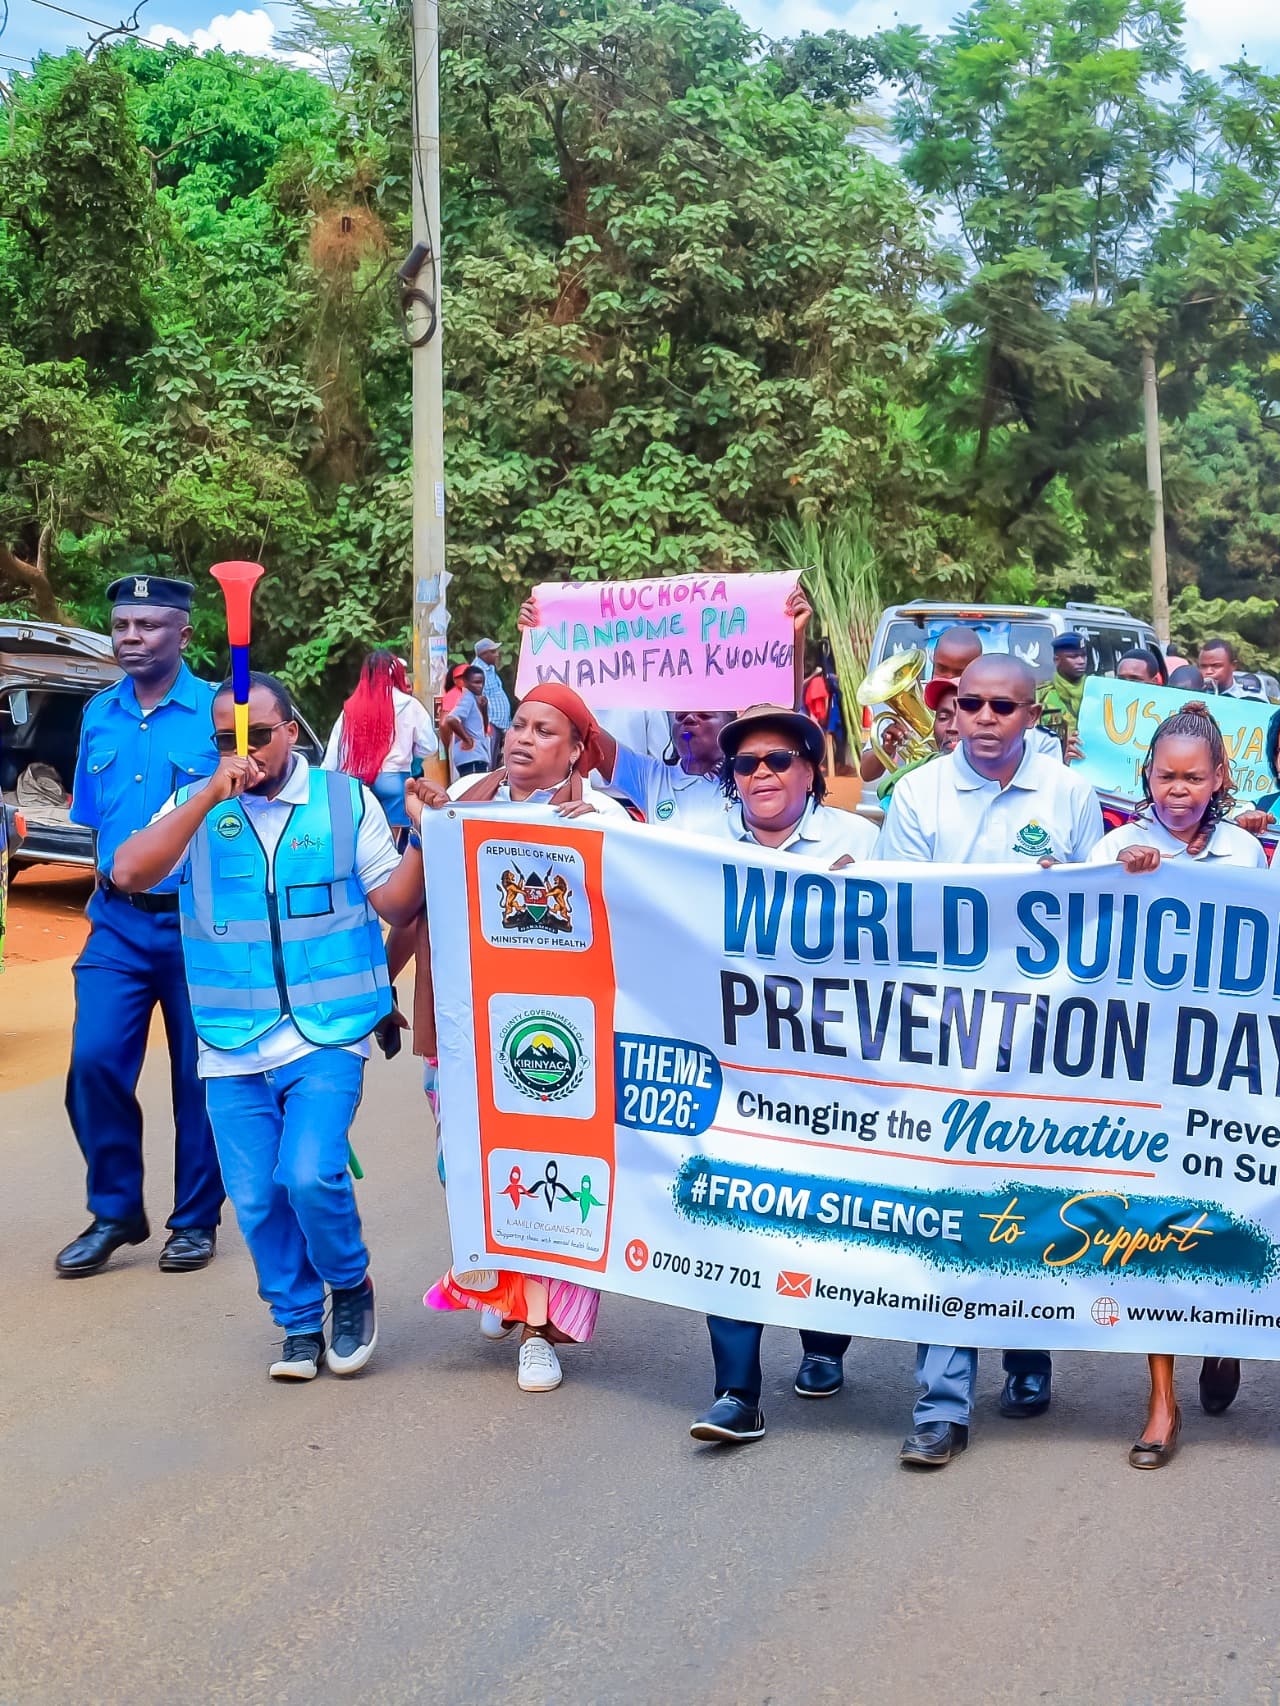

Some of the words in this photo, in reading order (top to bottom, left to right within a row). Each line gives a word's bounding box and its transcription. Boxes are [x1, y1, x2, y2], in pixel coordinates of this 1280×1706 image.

[600, 580, 728, 617] HUCHOKA
[530, 612, 687, 656] WANAUME
[701, 605, 747, 643] PIA
[536, 646, 693, 687] WANAFAA
[486, 845, 532, 857] REPUBLIC
[533, 850, 544, 858] OF
[546, 851, 576, 864] KENYA
[722, 863, 989, 972] WORLD
[491, 936, 535, 945] MINISTRY
[552, 938, 586, 948] HEALTH
[500, 1013, 522, 1039] COUNTY
[524, 1009, 577, 1034] GOVERNMENT
[720, 970, 1150, 1082] PREVENTION
[513, 1059, 572, 1071] KIRINYAGA
[620, 1041, 713, 1089] THEME
[623, 1083, 700, 1130] 2026:
[736, 1090, 880, 1142] Changing
[887, 1109, 932, 1142] the
[941, 1098, 1169, 1163] Narrative
[1182, 1151, 1223, 1179] on
[533, 1222, 593, 1238] ORGANISATION
[690, 1172, 811, 1219] #FROM
[816, 1191, 964, 1242] SILENCE
[979, 1197, 1026, 1244] to
[1043, 1191, 1214, 1267] Support
[652, 1250, 691, 1275] 0700
[694, 1259, 724, 1284] 327
[728, 1266, 762, 1289] 701
[814, 1277, 1076, 1325] kenyakamili@gmail.com
